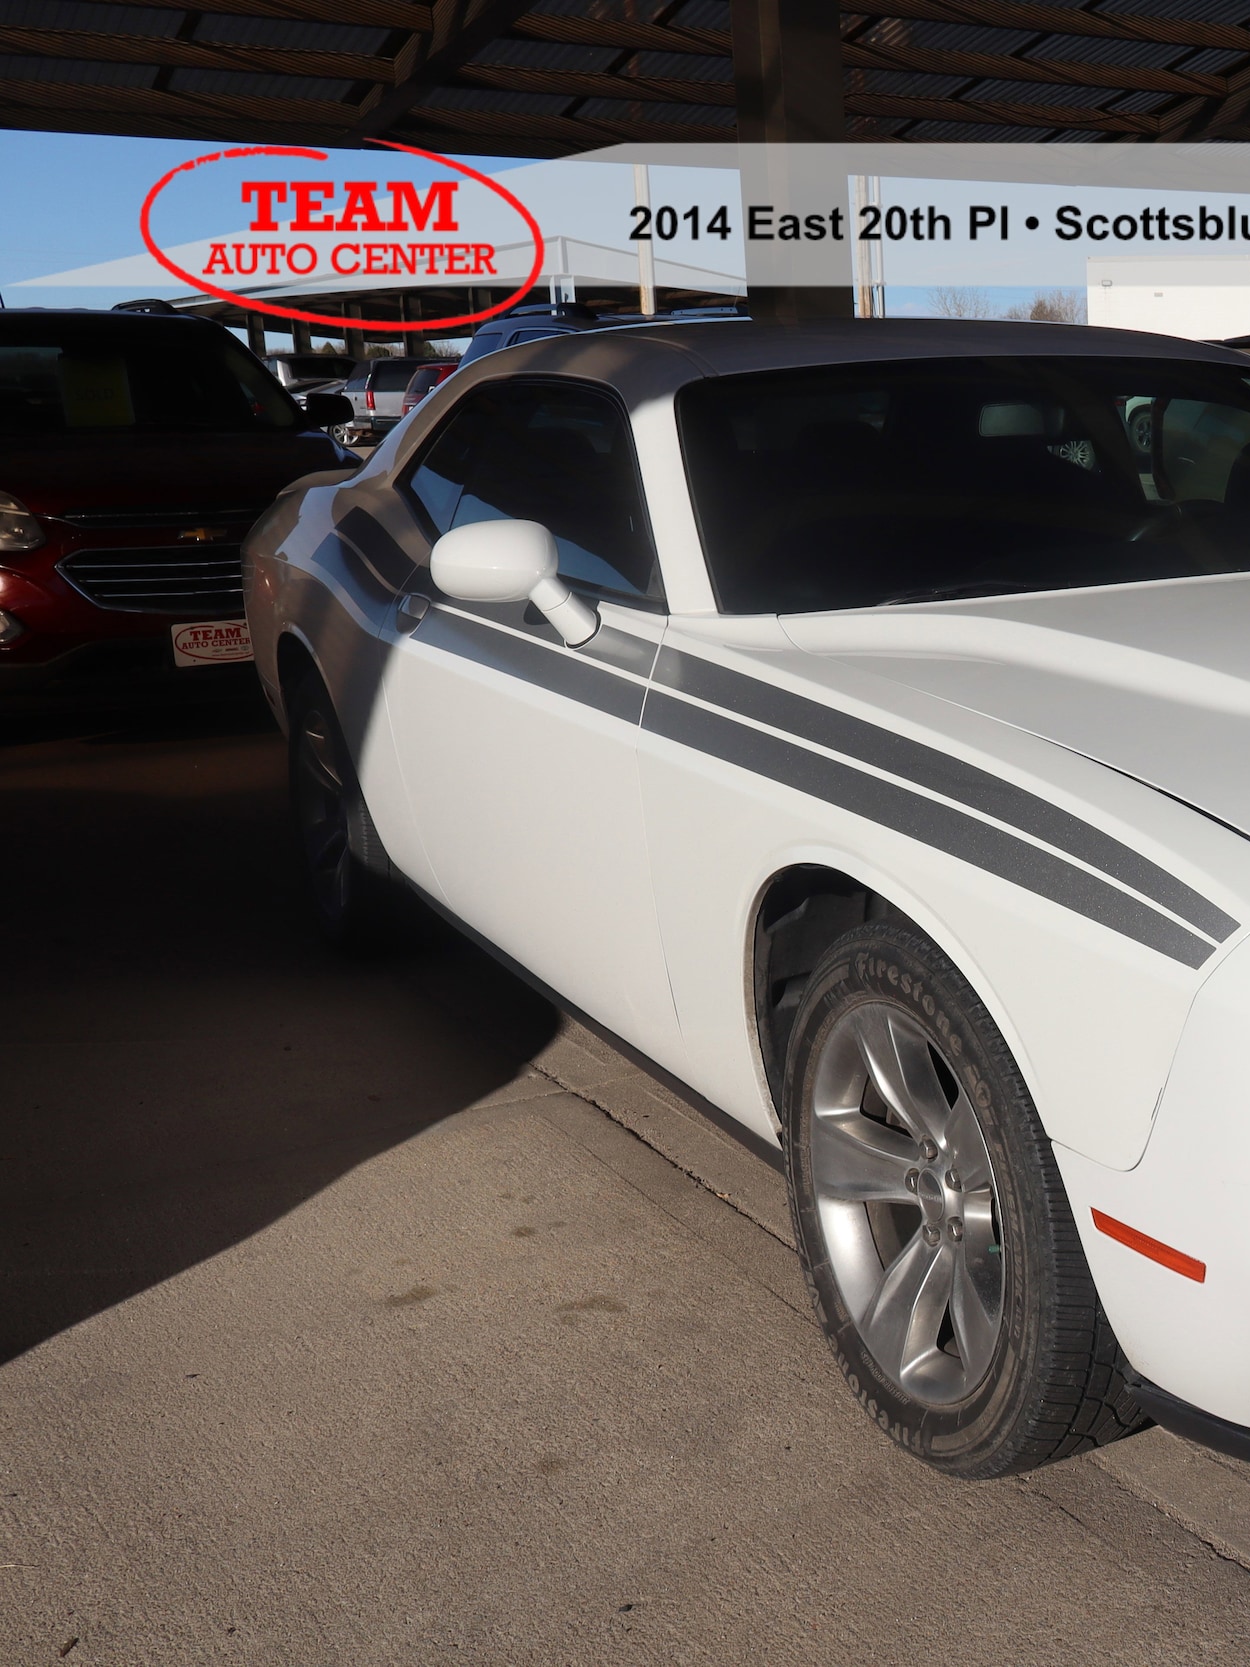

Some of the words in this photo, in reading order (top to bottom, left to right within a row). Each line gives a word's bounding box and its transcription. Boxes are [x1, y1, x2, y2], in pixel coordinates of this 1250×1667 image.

[190, 627, 242, 642] TEAM
[181, 641, 209, 650] AUTO
[212, 637, 251, 647] CENTER
